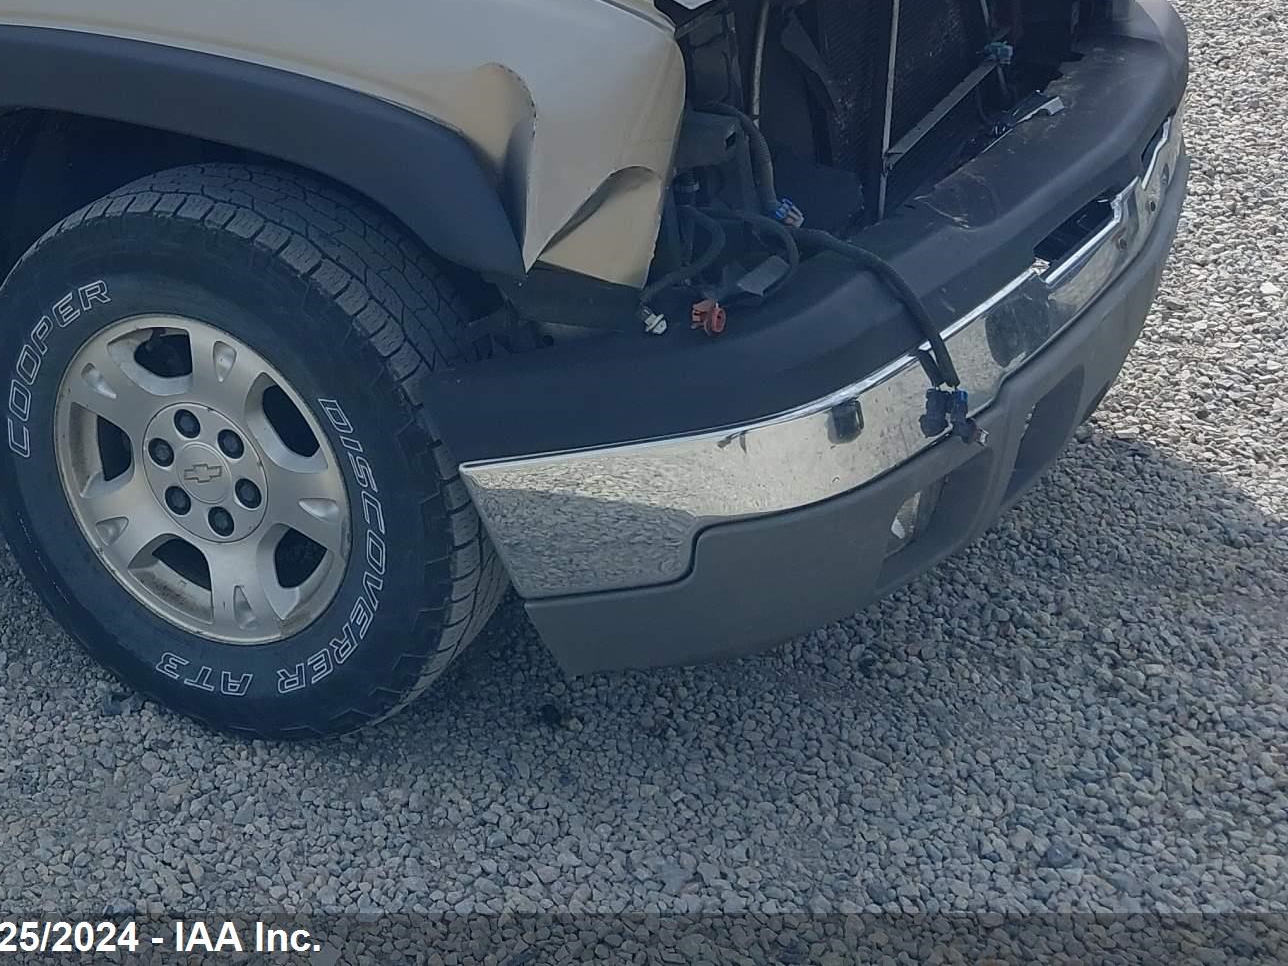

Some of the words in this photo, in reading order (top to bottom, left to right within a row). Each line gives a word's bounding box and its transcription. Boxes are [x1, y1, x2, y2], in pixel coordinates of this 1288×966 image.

[7, 279, 111, 459] COOPER
[277, 396, 388, 696] DISCOVERER
[154, 650, 255, 698] AT3
